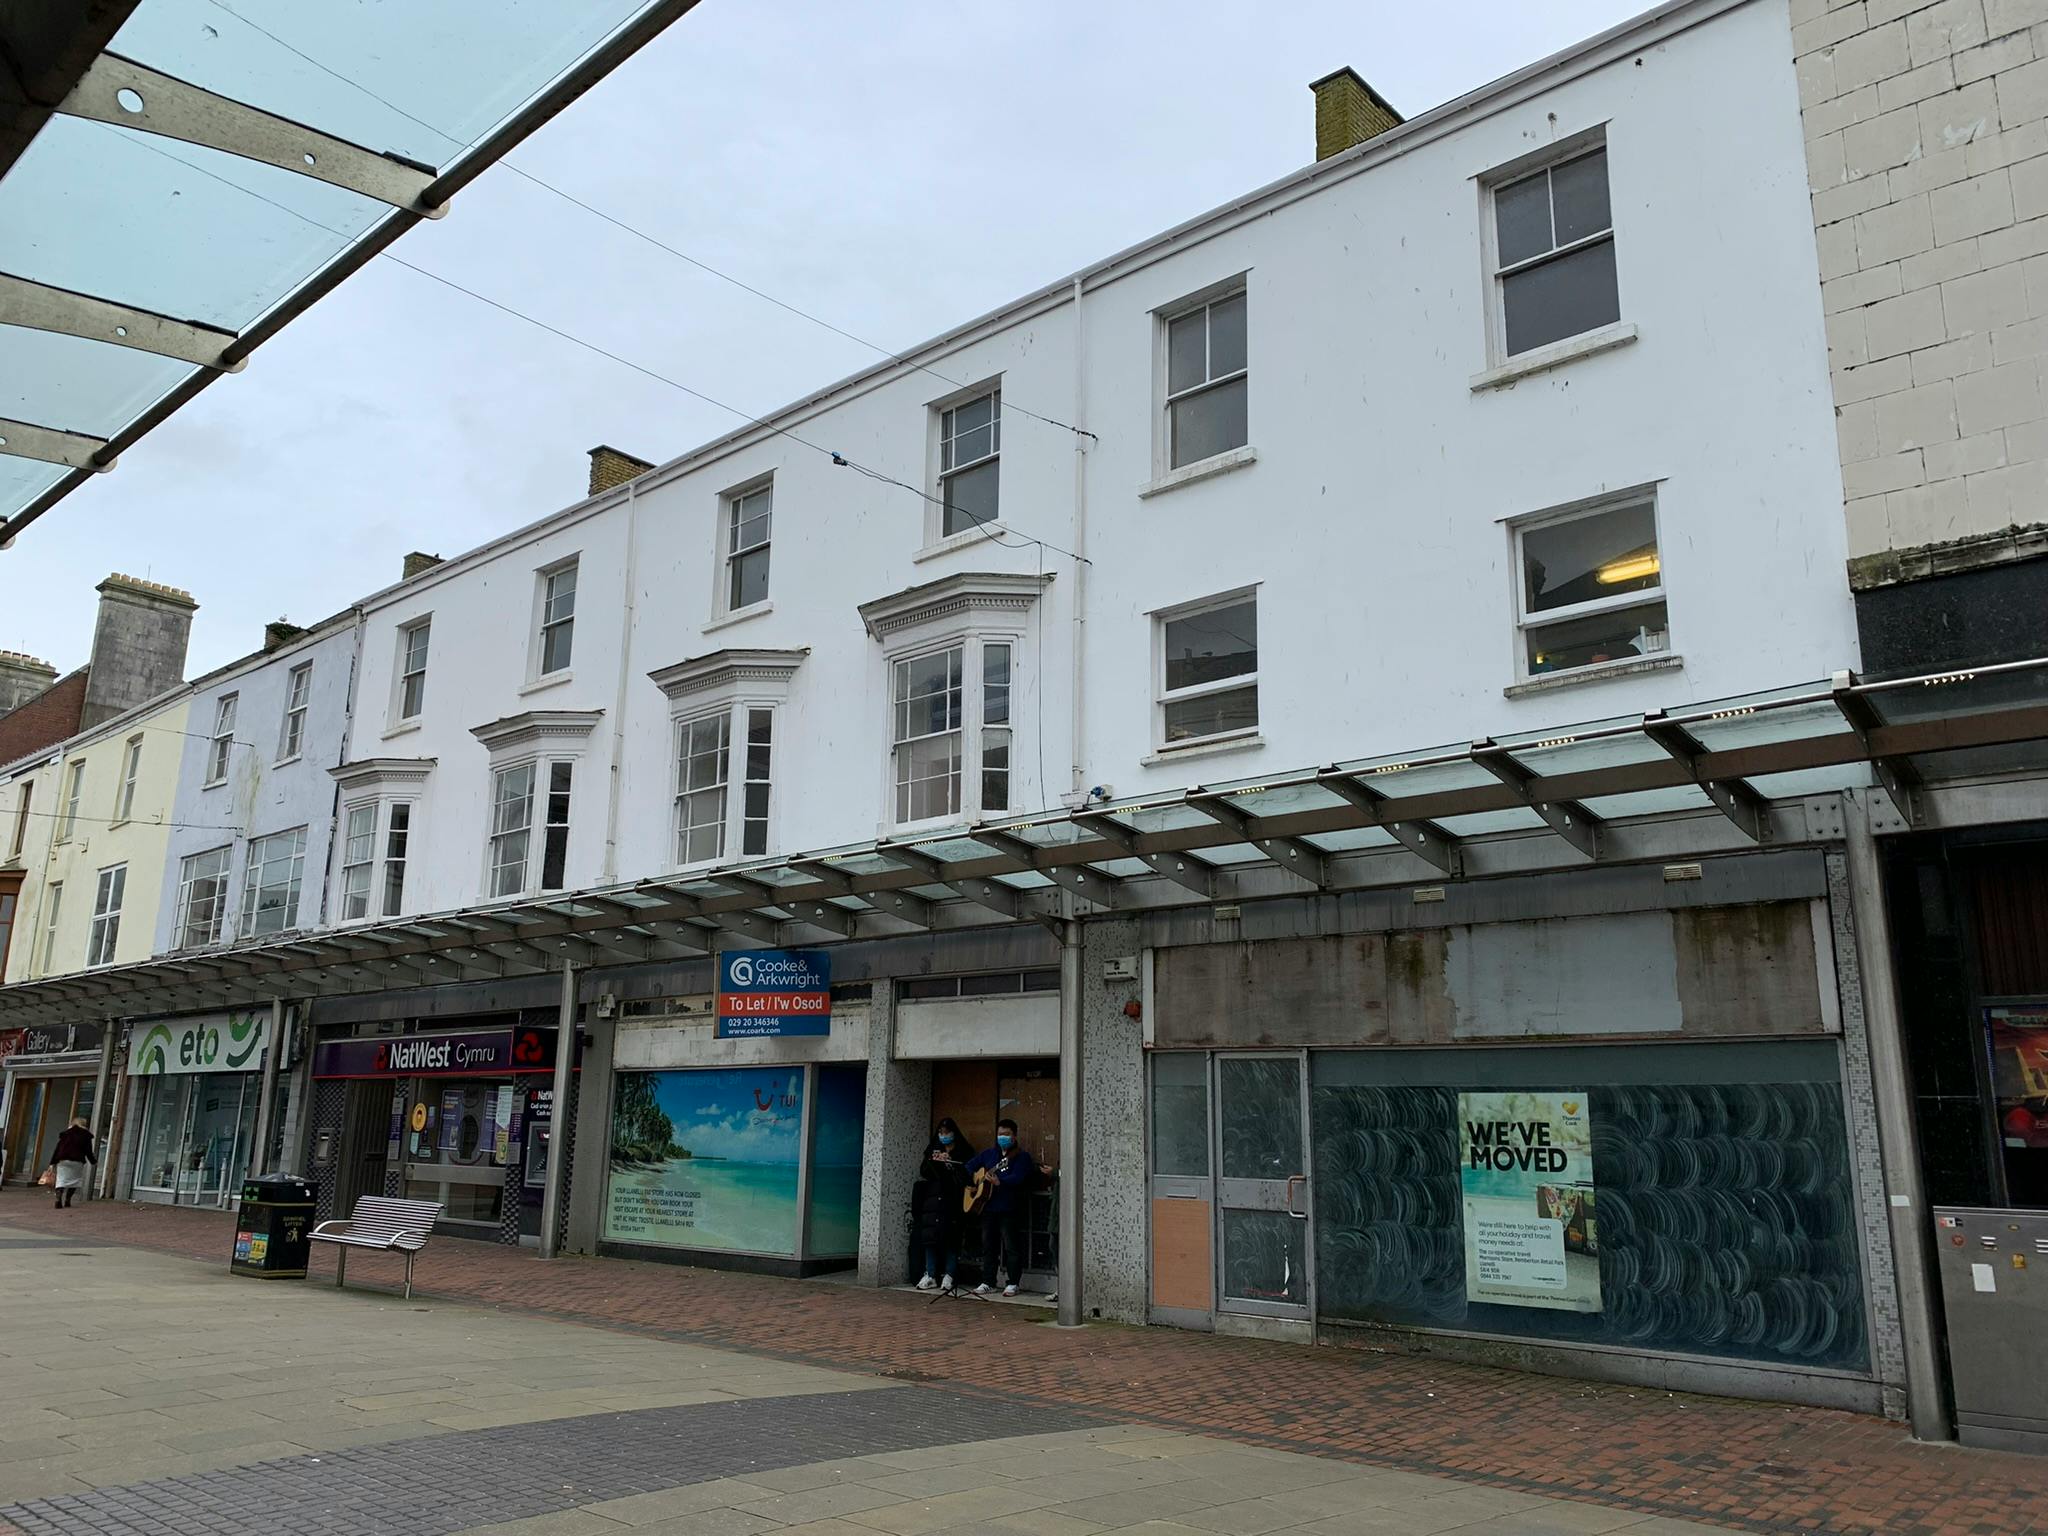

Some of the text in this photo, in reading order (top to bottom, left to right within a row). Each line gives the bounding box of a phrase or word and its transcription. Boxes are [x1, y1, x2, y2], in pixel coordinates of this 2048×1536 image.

[756, 959, 808, 973] Cooke&
[756, 973, 821, 988] Arkwright
[729, 996, 823, 1011] To Let / I'w Osod
[728, 1017, 780, 1027] 029 20 346346
[180, 1023, 220, 1067] eto
[389, 1040, 495, 1069] NatWest Cymru
[780, 1095, 796, 1107] TUI
[1466, 1121, 1551, 1147] WE'VE
[1470, 1146, 1568, 1173] MOVED
